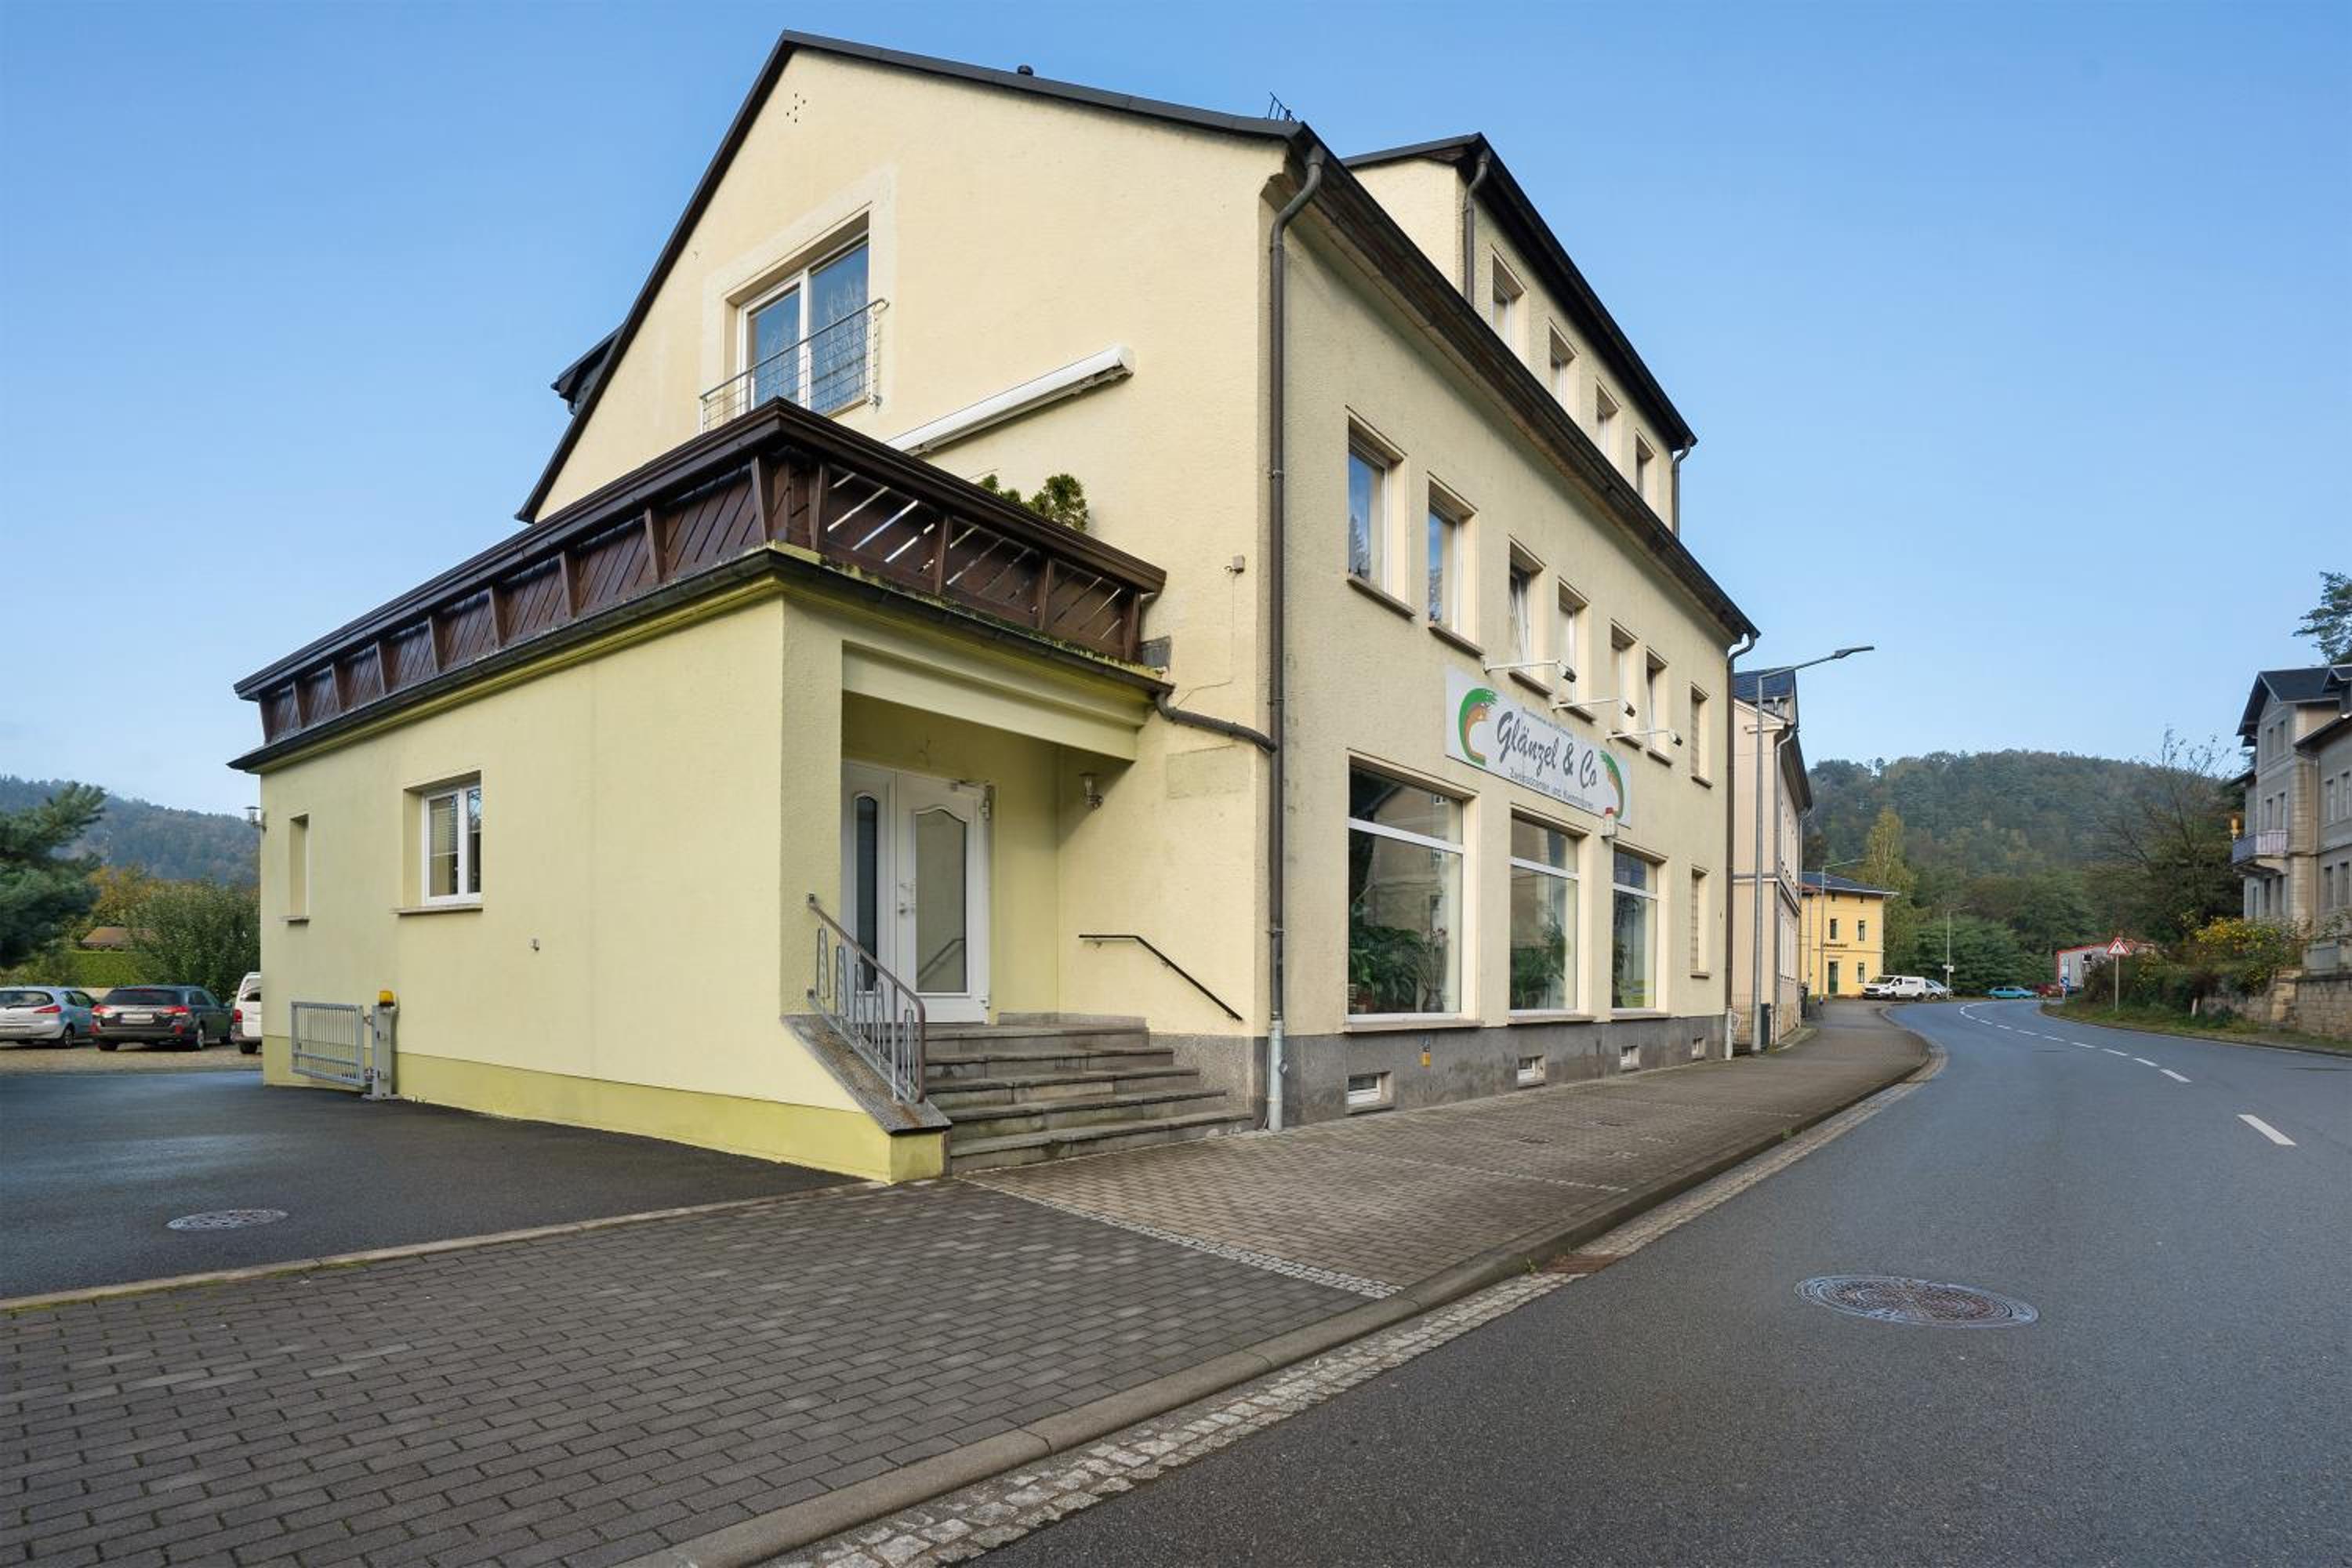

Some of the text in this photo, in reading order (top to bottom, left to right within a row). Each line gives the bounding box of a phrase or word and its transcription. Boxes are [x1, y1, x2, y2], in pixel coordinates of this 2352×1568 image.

[1497, 711, 1559, 777] Glänzel
[1563, 742, 1573, 776] &
[1580, 750, 1597, 789] Co
